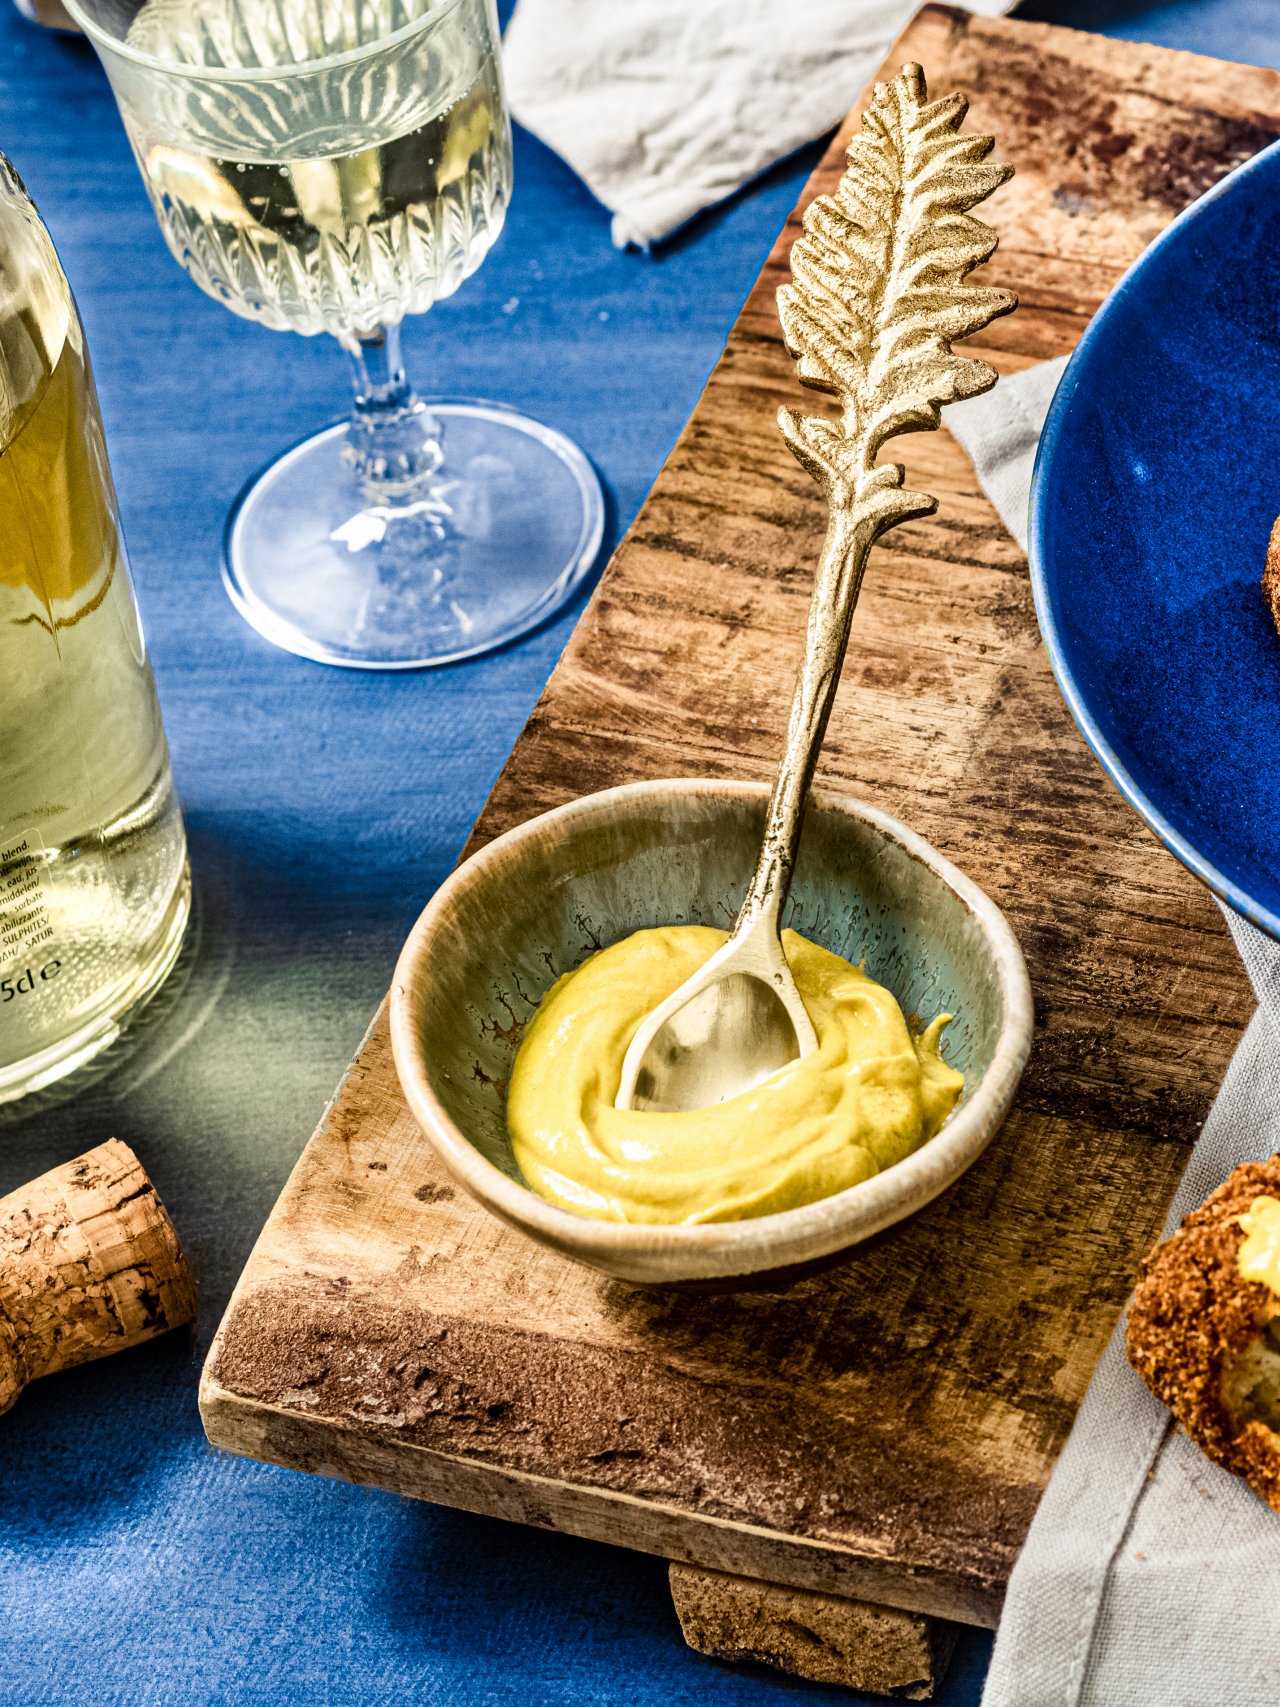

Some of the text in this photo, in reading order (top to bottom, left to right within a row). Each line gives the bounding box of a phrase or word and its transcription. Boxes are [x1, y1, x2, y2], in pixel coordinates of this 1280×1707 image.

[2, 840, 30, 862] blend.
[7, 875, 24, 888] eau,
[25, 865, 38, 880] jus
[15, 892, 43, 913] sorbate
[0, 904, 47, 935] abilizzante:
[25, 927, 54, 950] SATUR
[1, 968, 35, 1003] 5cl
